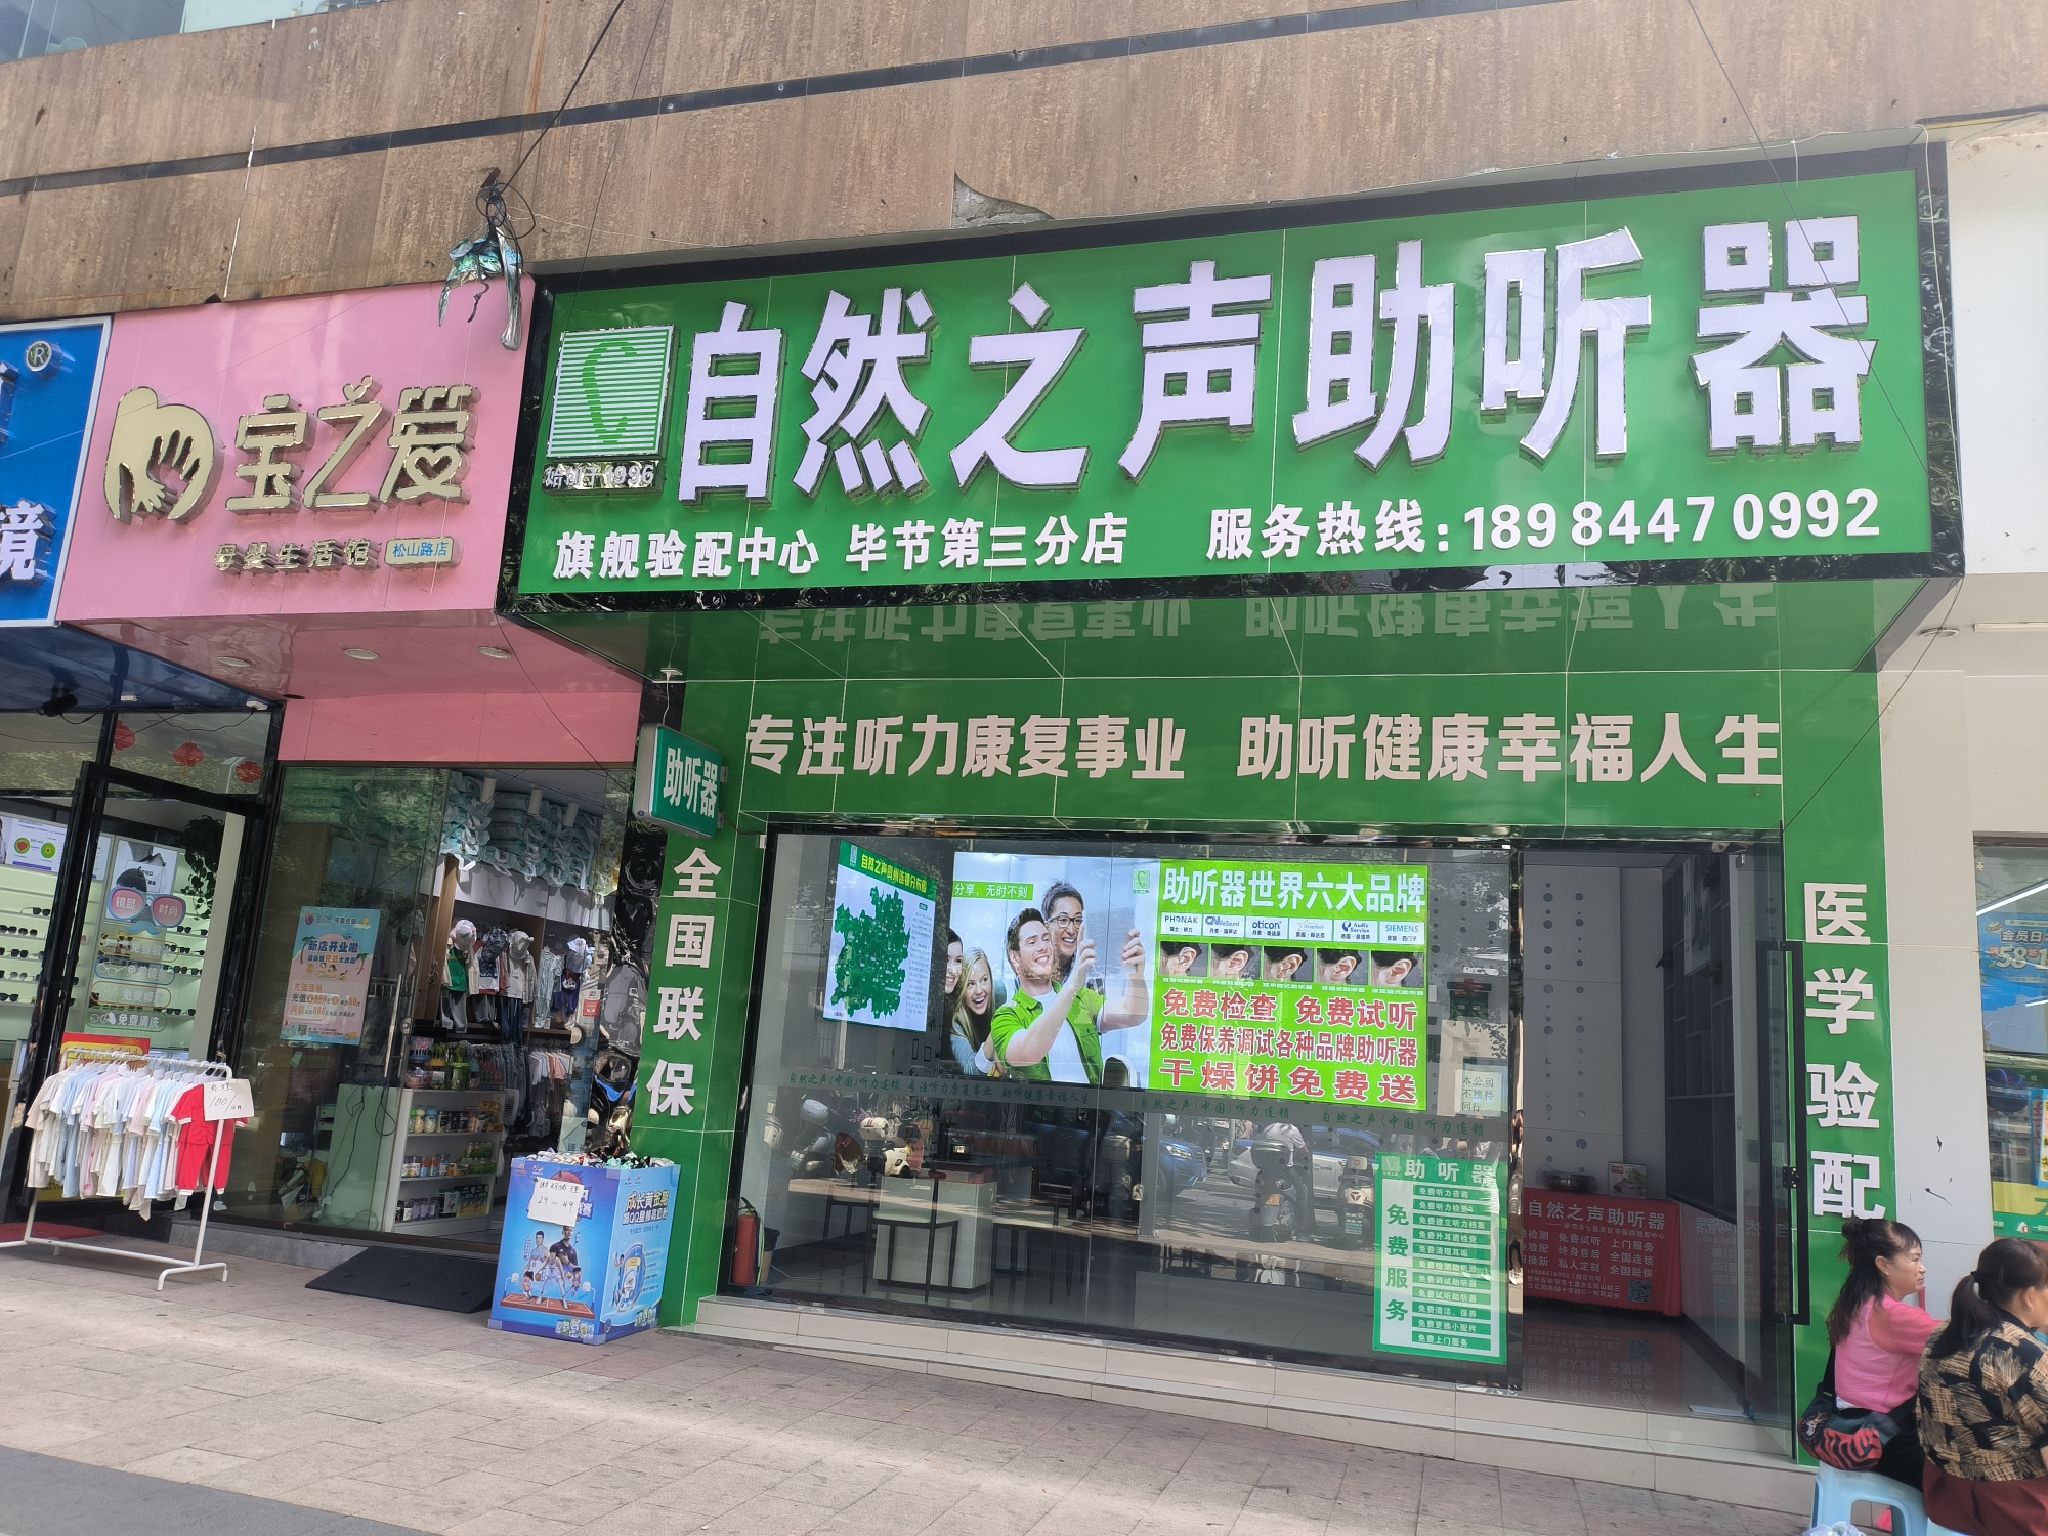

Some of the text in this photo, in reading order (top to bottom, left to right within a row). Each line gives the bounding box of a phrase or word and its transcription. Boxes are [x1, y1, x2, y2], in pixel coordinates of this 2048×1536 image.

[678, 214, 1877, 503] 自然之声助听器
[544, 464, 655, 490] 始创于1996
[392, 542, 449, 558] 松山路店
[553, 511, 1129, 580] 旗舰验配中心 毕节第三分店
[746, 713, 1784, 784] 专注听力康复事业 助听健康幸福人生
[663, 747, 722, 819] 助听器
[1162, 867, 1426, 913] 助听器世界六大品牌
[1252, 921, 1280, 929] oticon
[1385, 924, 1419, 932] SIEMENS
[308, 941, 358, 953] 新店开业啦
[646, 848, 722, 1116] 全国联保
[1162, 987, 1418, 1032] 免费检查 免费试听
[1160, 1022, 1418, 1067] 免费保养调试各种品牌助听器
[1803, 882, 1886, 1220] 医学验配
[1159, 1058, 1418, 1104] 干燥饼免费送
[1462, 1088, 1494, 1100] 不接待
[1461, 1101, 1482, 1112] 同行
[1405, 1159, 1497, 1184] 助听器
[1419, 1187, 1468, 1198] 免费听力咨询
[1419, 1201, 1469, 1212] 免费听力检查
[1529, 1200, 1665, 1230] 自然之声助听器
[1419, 1217, 1486, 1230] 免费建立听力档案
[1559, 1232, 1600, 1246] 免费试听
[1610, 1239, 1655, 1253] 上门服务
[1386, 1204, 1409, 1321] 免费服务
[1558, 1245, 1600, 1258] 终身售后
[1610, 1251, 1654, 1266] 全国连锁
[1558, 1257, 1600, 1273] 私人定制
[1609, 1264, 1653, 1279] 全国联保
[1418, 1319, 1478, 1333] 免费更换小配件
[1417, 1334, 1468, 1348] 免费上门服务
